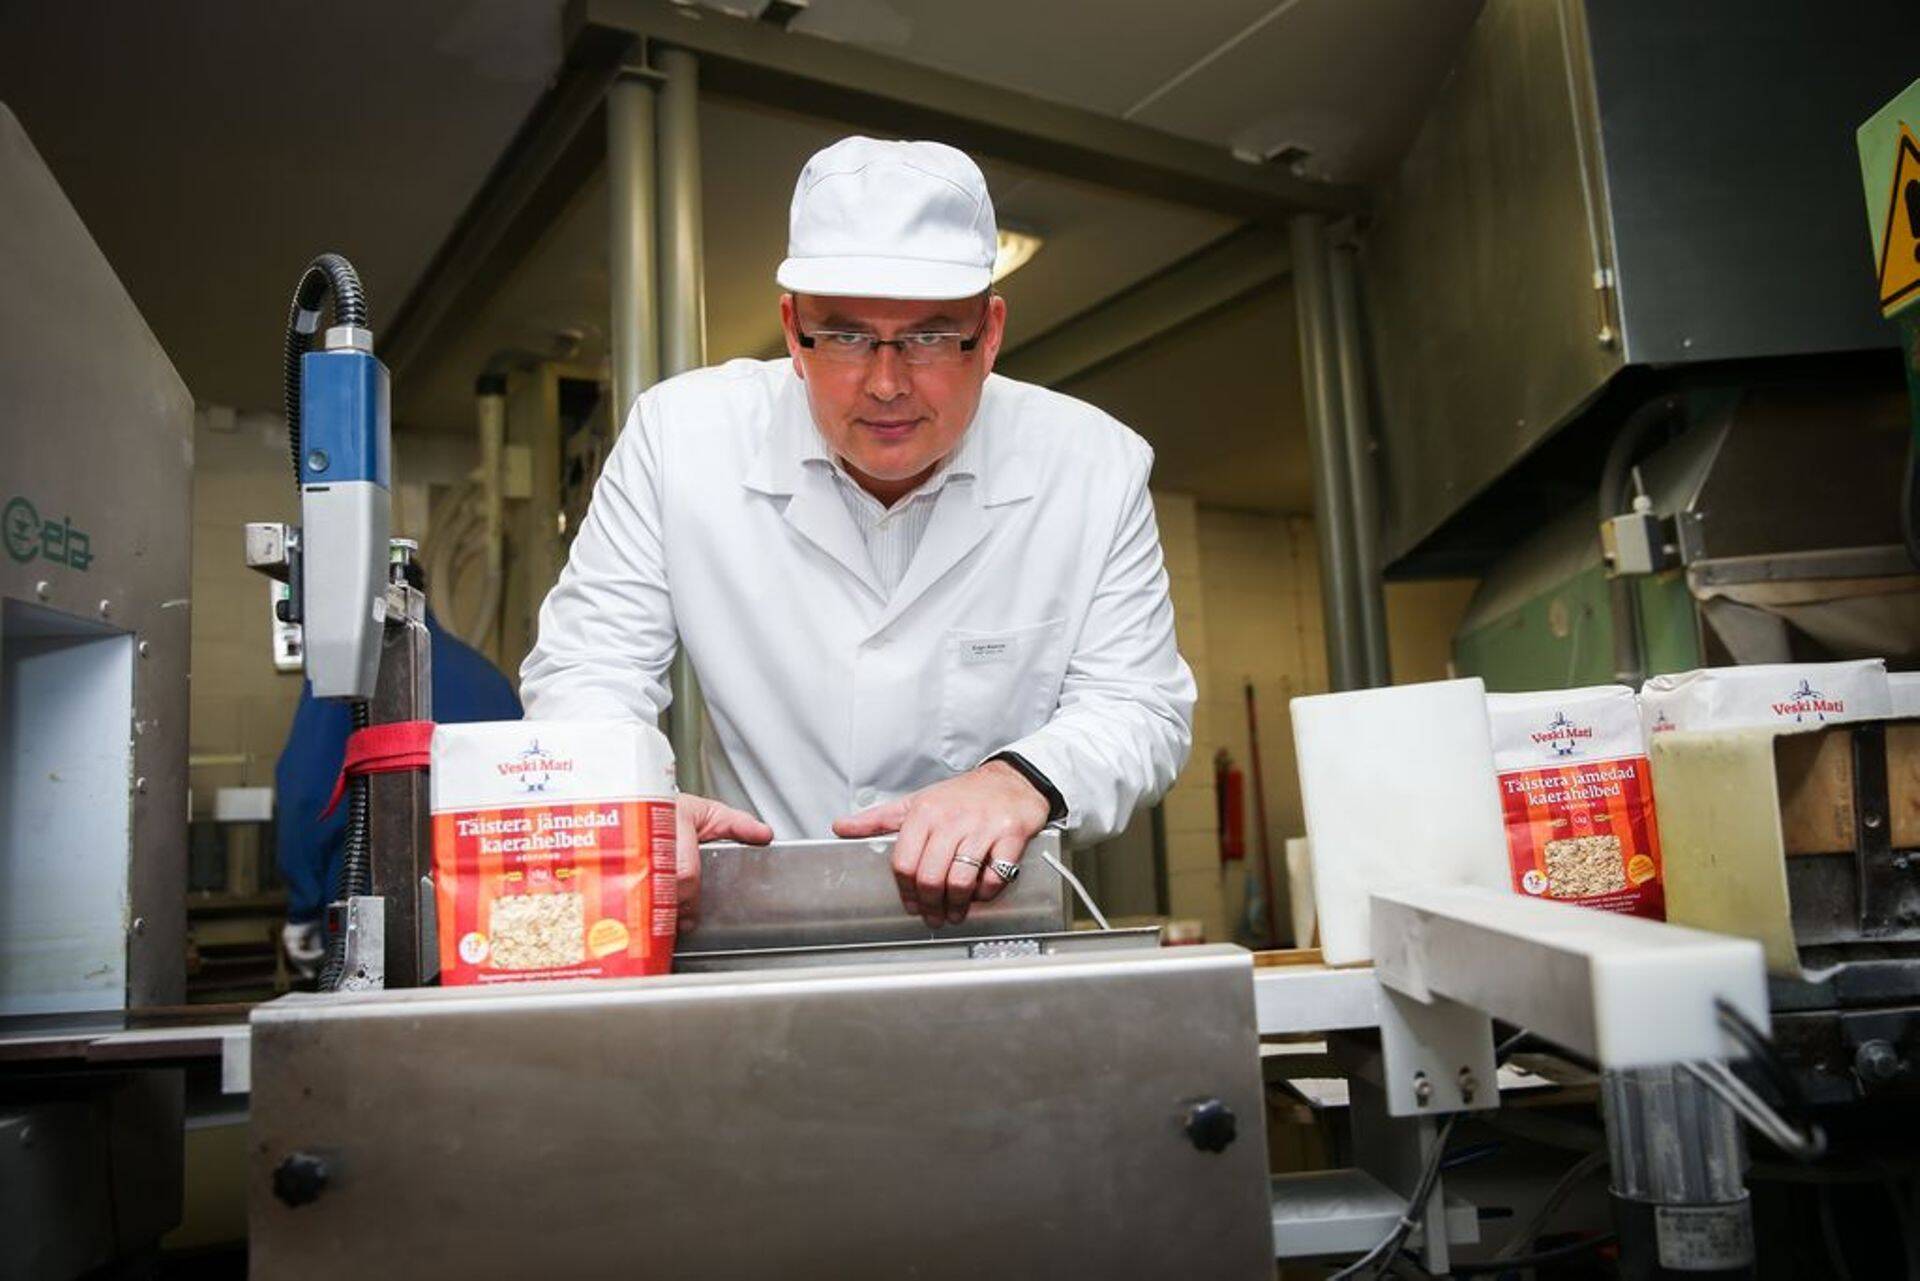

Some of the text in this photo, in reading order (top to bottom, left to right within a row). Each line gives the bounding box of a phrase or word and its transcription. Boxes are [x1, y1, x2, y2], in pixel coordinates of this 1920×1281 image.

[1772, 700, 1844, 716] Veski Mati
[1531, 727, 1592, 744] Veski Mati
[497, 758, 573, 776] Veski Mati
[1504, 775, 1568, 793] Täistera
[1527, 782, 1620, 805] kaerahelbed
[456, 809, 620, 837] Täistera jämedad
[480, 829, 597, 854] kaerahelbed
